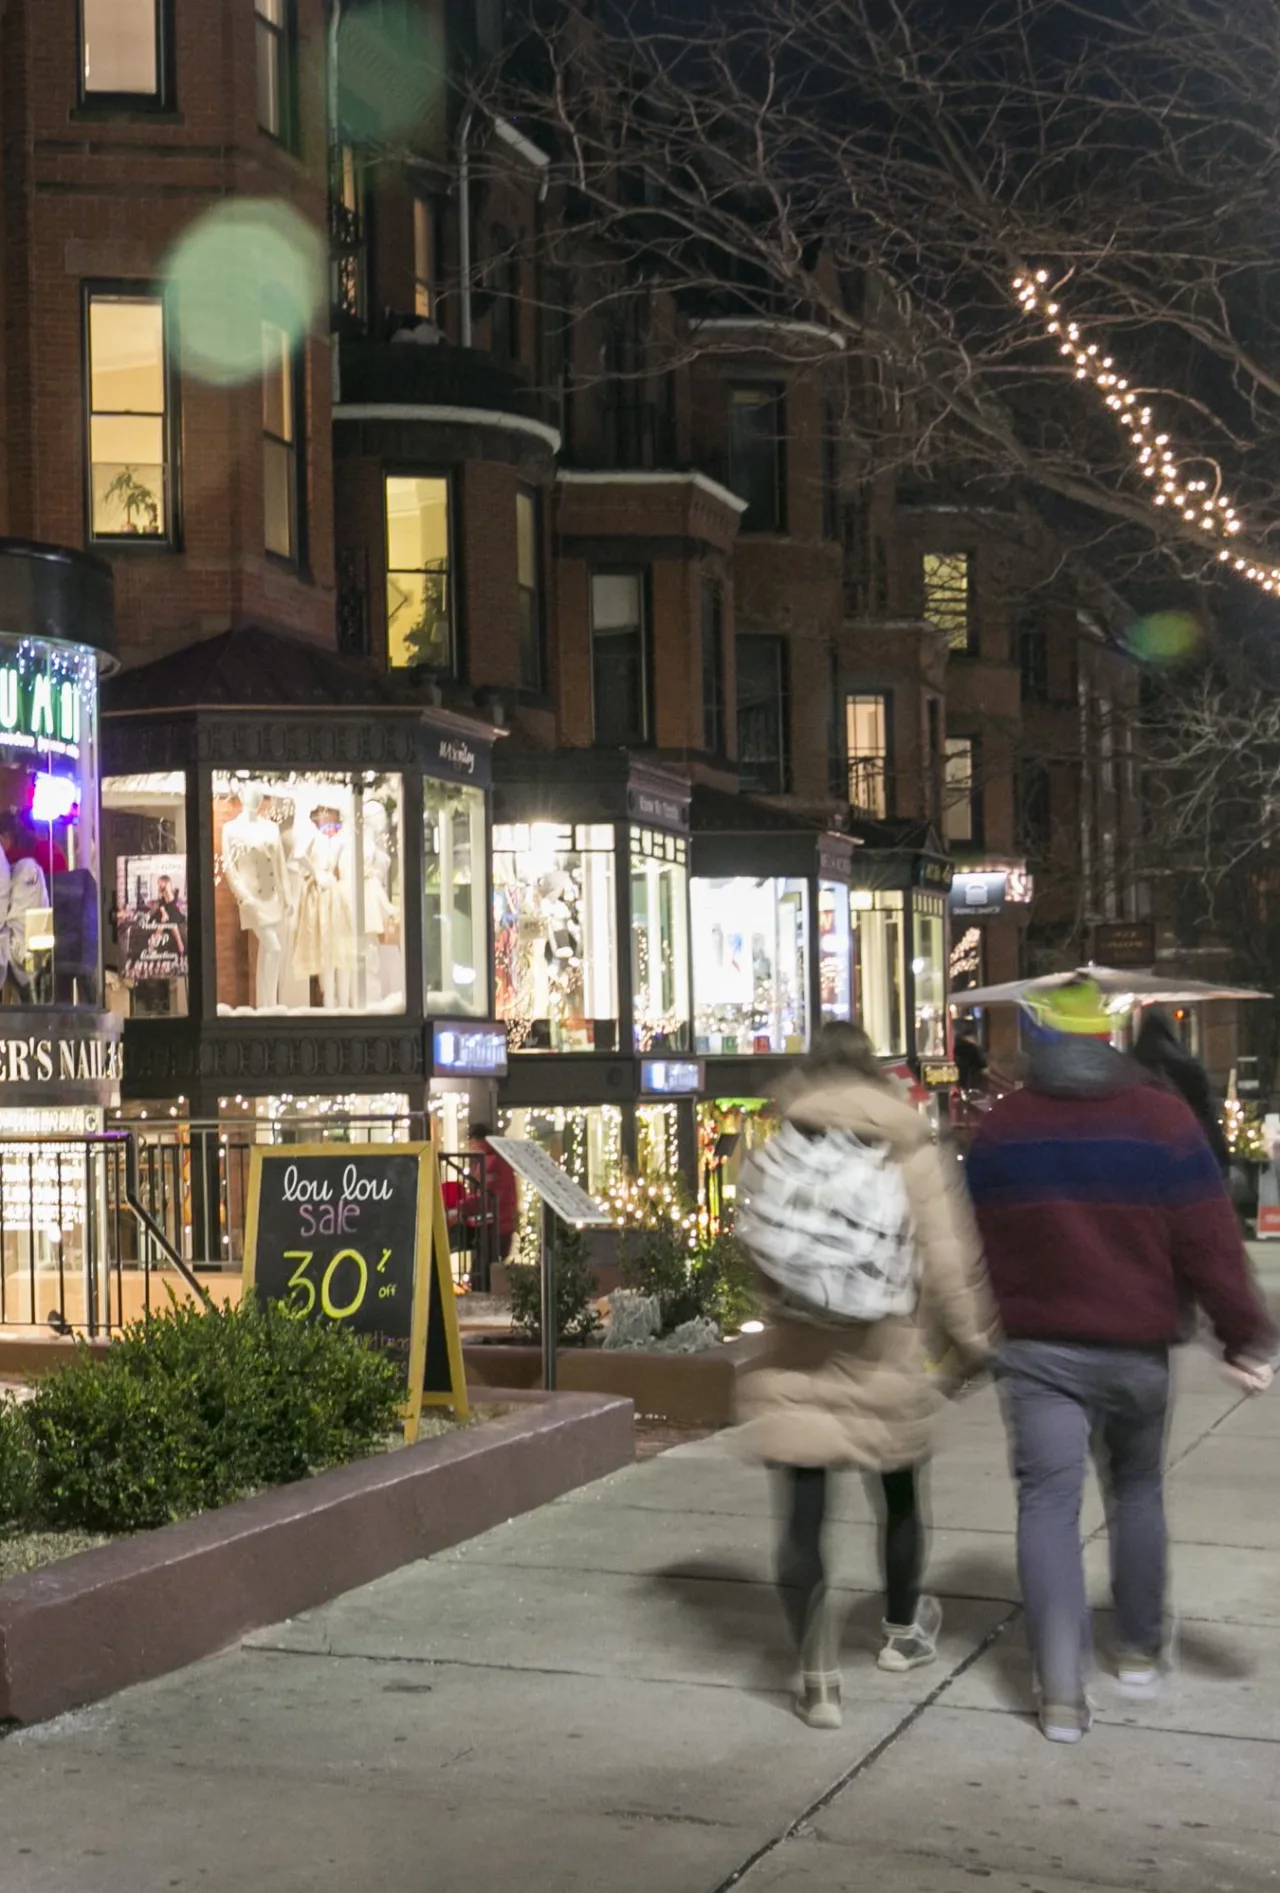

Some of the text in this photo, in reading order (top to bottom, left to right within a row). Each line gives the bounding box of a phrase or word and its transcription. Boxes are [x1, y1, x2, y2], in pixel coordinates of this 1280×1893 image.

[282, 1163, 394, 1202] lou lou
[299, 1200, 361, 1237] sale
